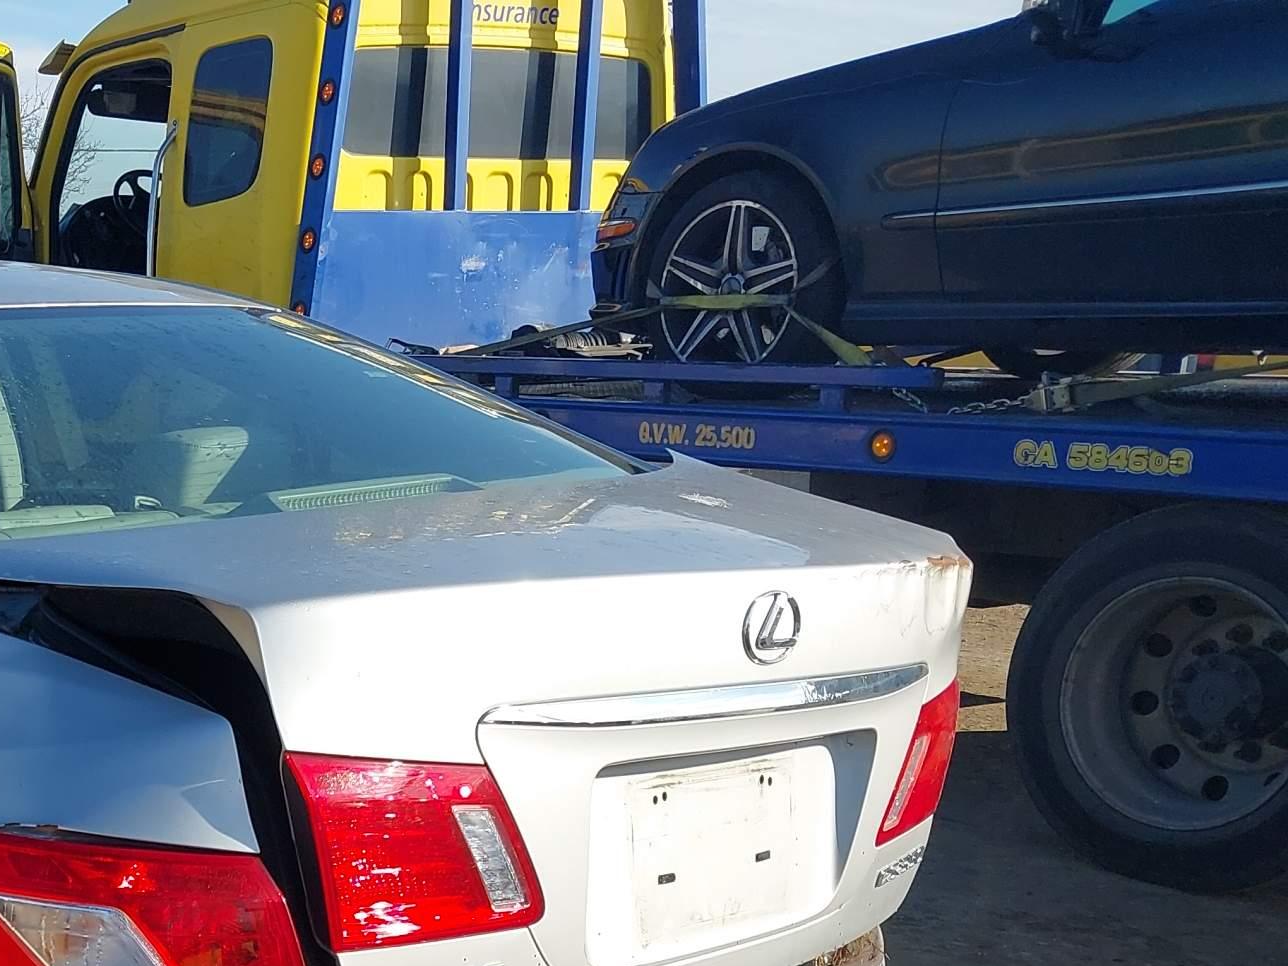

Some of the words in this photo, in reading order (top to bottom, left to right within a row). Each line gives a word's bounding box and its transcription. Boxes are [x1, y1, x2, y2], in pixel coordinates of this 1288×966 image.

[472, 3, 559, 24] nsurance
[695, 424, 755, 449] 25,500
[1013, 439, 1058, 468] CA
[1067, 442, 1193, 476] 584603
